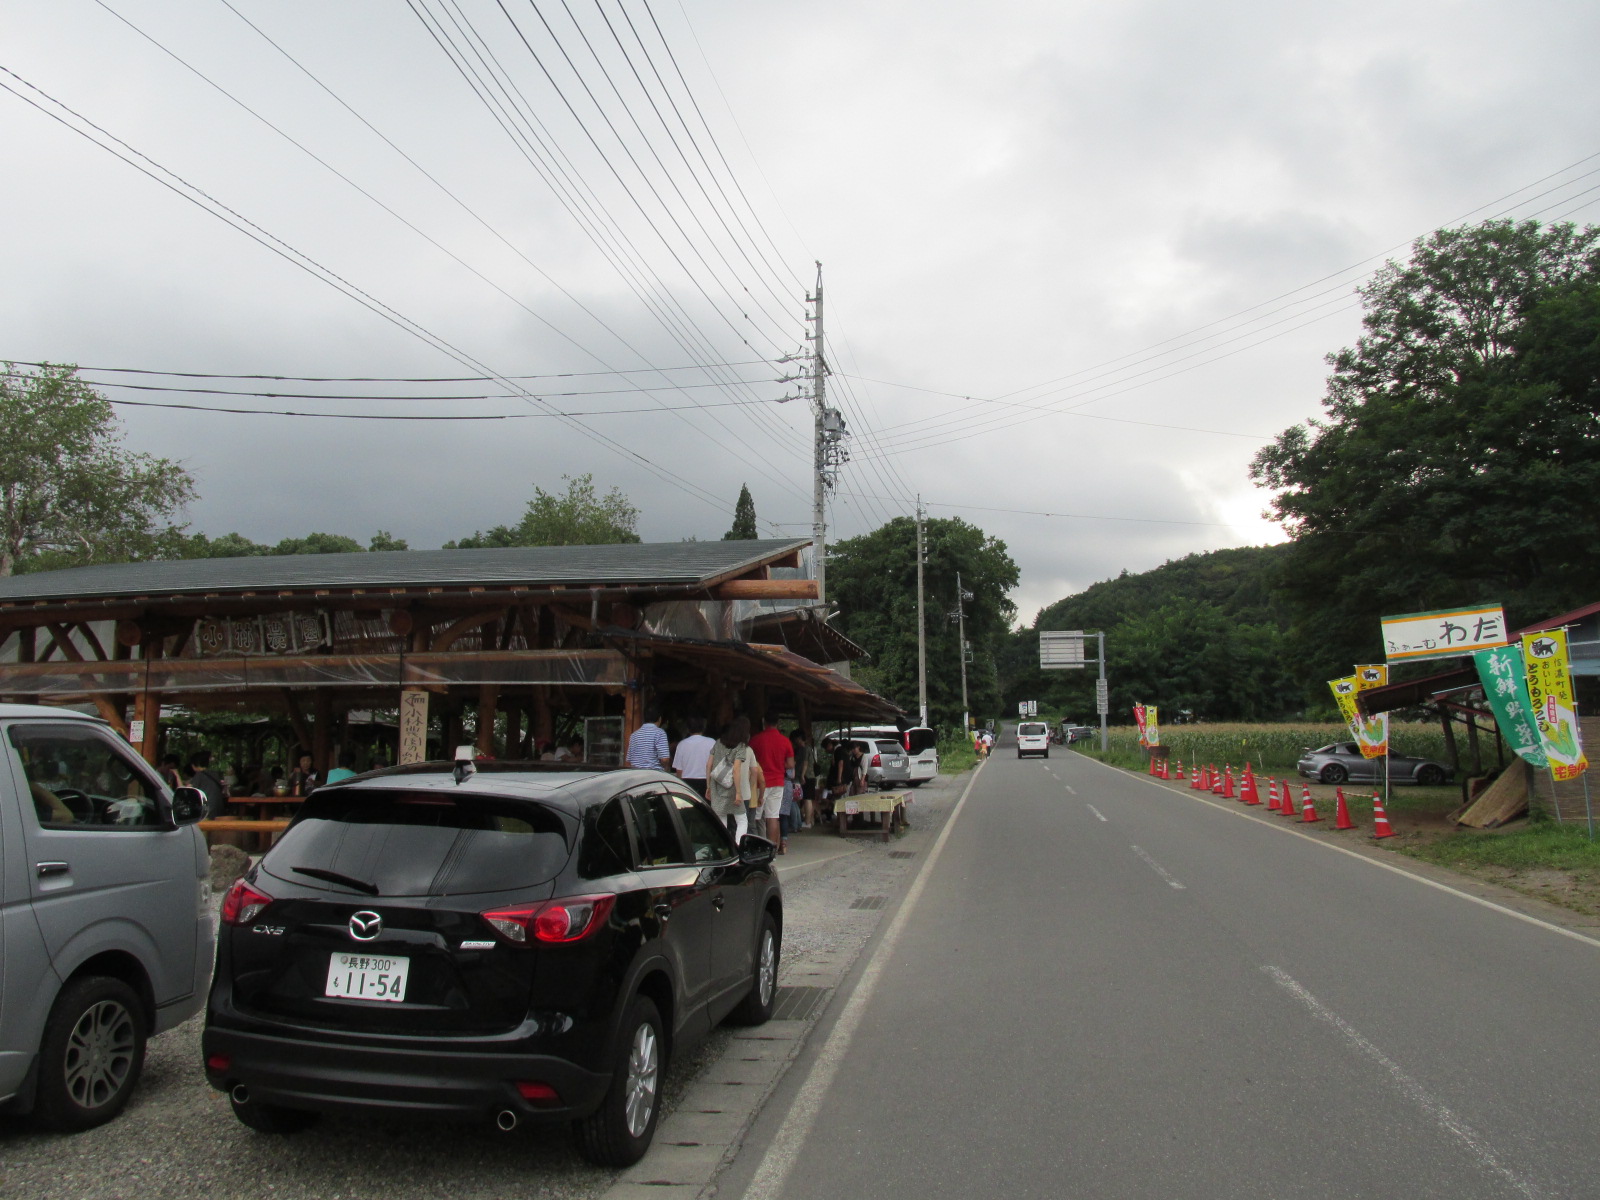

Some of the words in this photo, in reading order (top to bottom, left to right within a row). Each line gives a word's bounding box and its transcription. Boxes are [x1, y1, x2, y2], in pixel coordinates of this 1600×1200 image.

[1439, 615, 1502, 645] わだ
[1542, 661, 1553, 696] おいしい
[1486, 653, 1534, 745] 新鮮野菜
[252, 924, 286, 936] CX-5
[346, 971, 402, 998] 11-54
